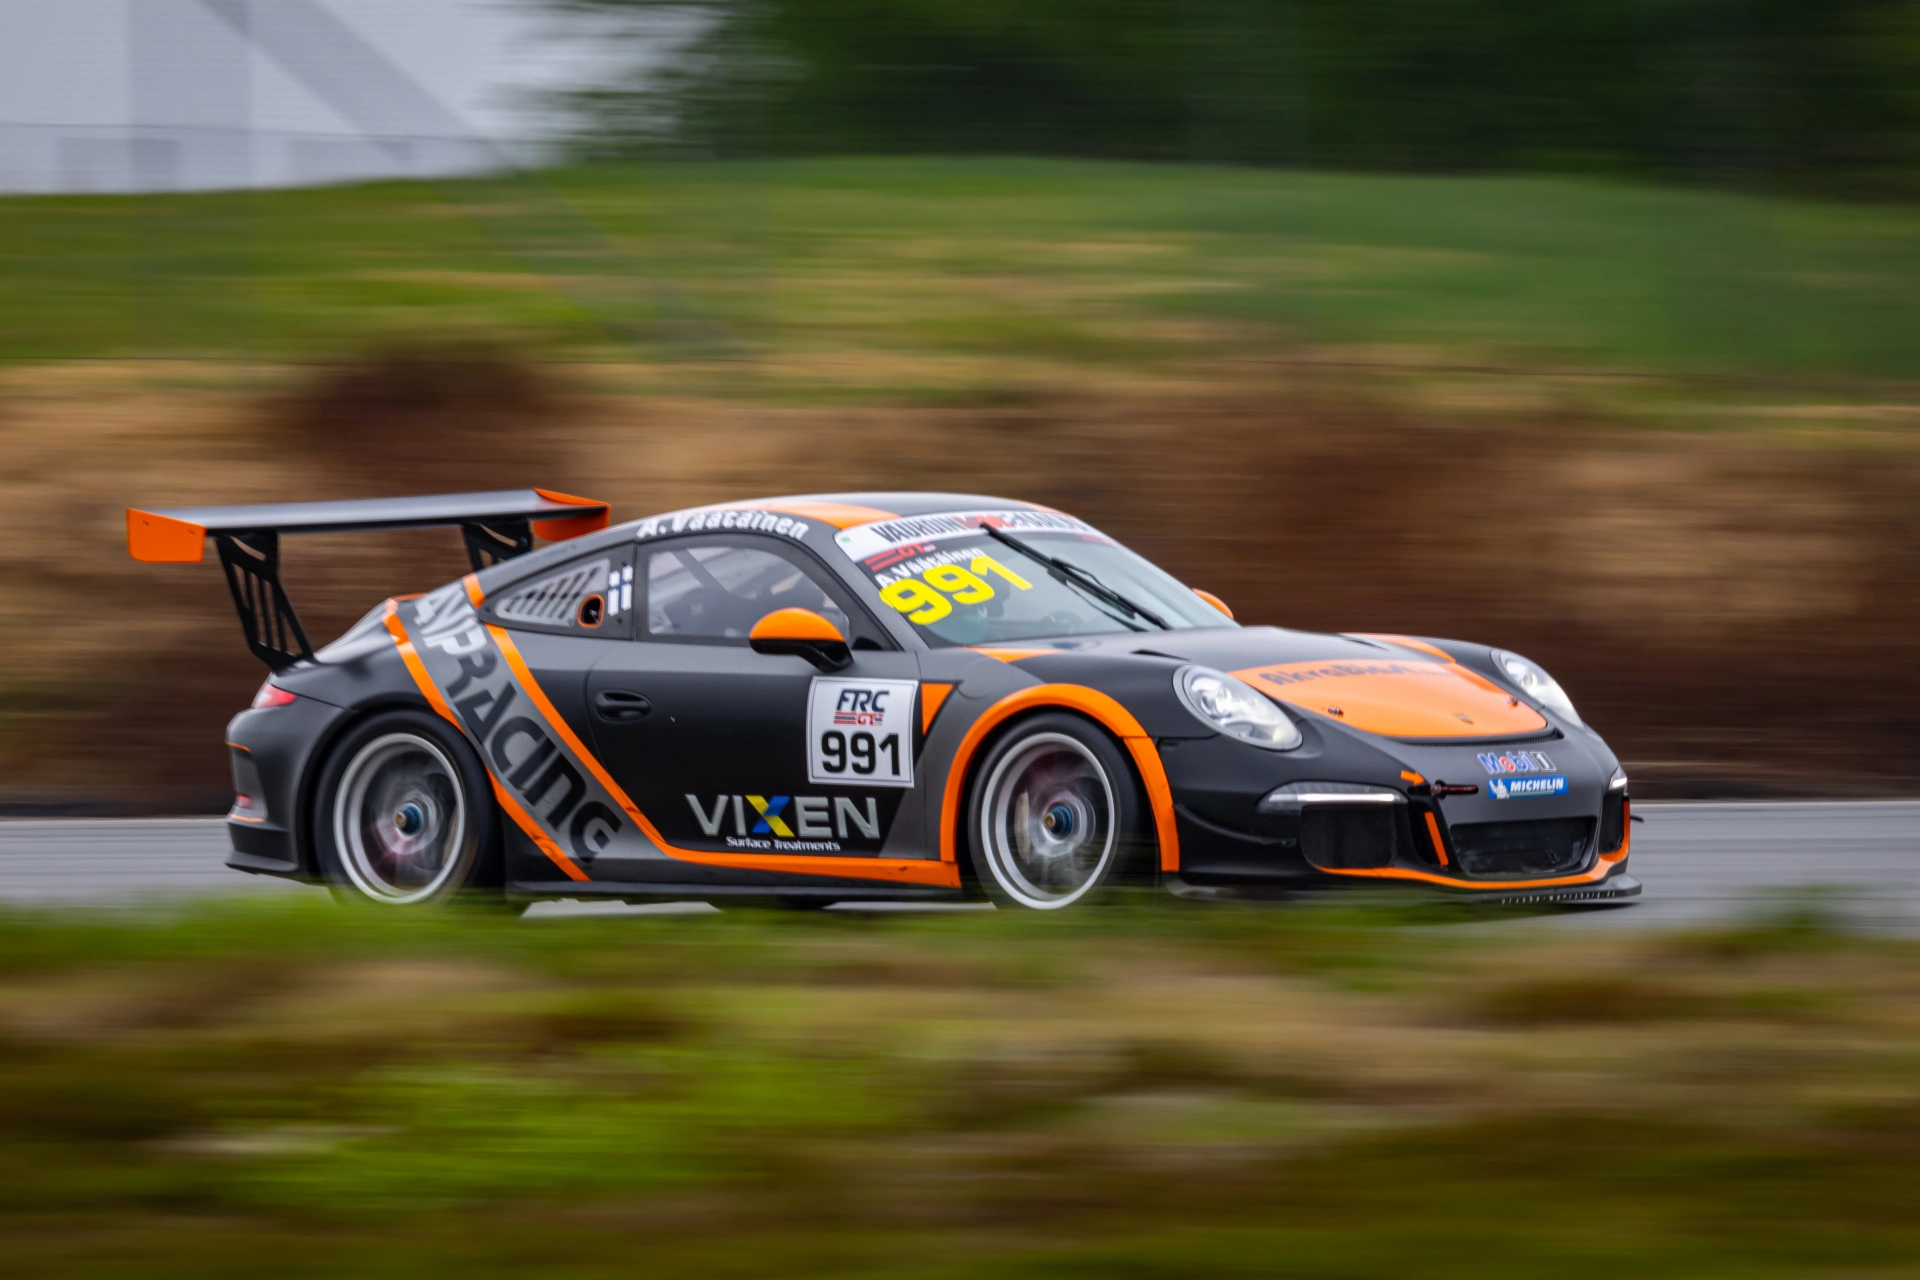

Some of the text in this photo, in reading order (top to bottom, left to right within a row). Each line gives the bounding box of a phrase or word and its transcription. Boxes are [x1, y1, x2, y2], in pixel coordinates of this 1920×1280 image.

[879, 554, 1033, 625] 991
[836, 688, 890, 713] FRC
[820, 730, 902, 777] 991
[1477, 750, 1539, 775] Mobil
[1510, 778, 1564, 793] MICHELIN
[684, 793, 880, 839] VIXEN
[726, 836, 840, 852] Surface Treatments
